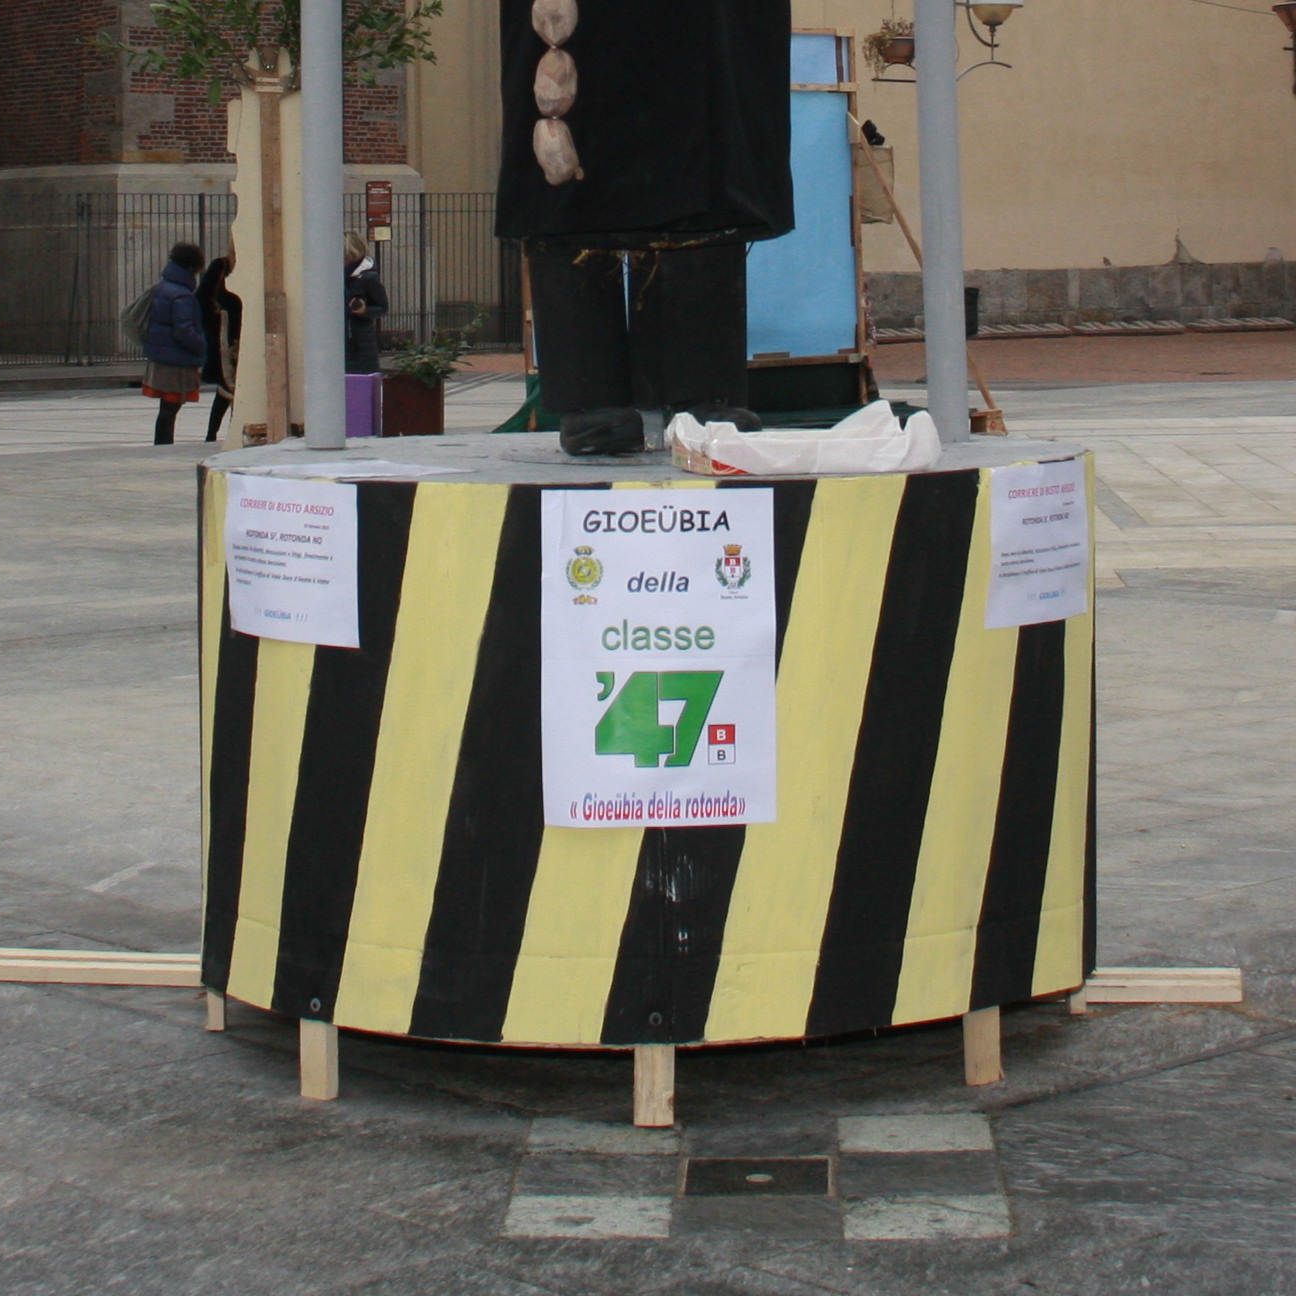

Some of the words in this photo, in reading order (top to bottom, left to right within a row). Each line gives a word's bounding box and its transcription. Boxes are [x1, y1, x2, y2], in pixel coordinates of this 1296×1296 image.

[276, 502, 302, 514] BUSTO
[304, 504, 335, 517] ARSIZIO
[583, 505, 730, 533] GIOEÜBIA
[279, 532, 310, 544] ROTONDA
[627, 571, 690, 593] della
[601, 619, 715, 651] classe
[595, 670, 725, 768] '47
[716, 729, 727, 741] B
[716, 750, 727, 761] B
[582, 792, 643, 821] Gioeübia
[647, 791, 680, 820] della
